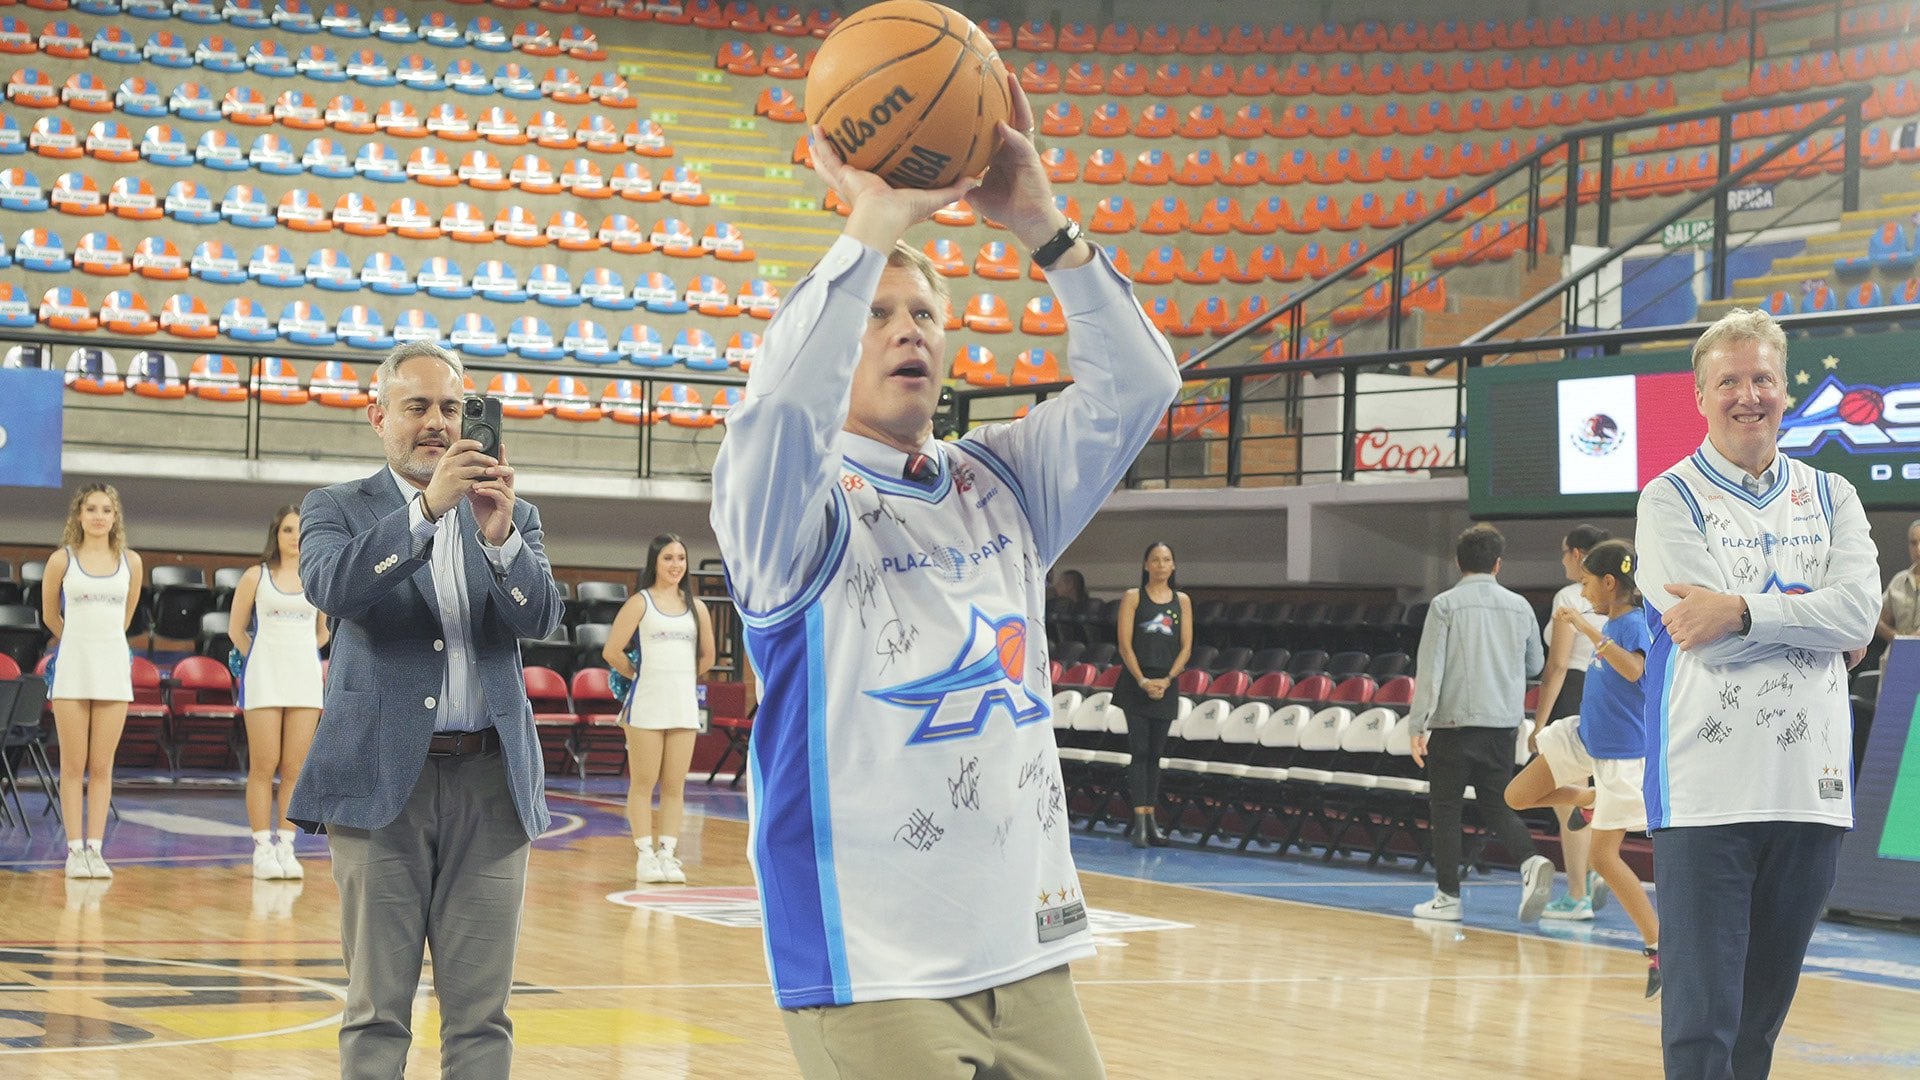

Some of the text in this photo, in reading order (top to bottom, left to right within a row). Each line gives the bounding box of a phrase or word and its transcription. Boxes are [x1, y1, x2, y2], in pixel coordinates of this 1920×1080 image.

[887, 145, 952, 187] NBA
[1727, 188, 1773, 211] RENSA
[1353, 428, 1456, 474] Coor
[1722, 537, 1761, 548] PLAZA
[881, 552, 932, 572] PLAZ
